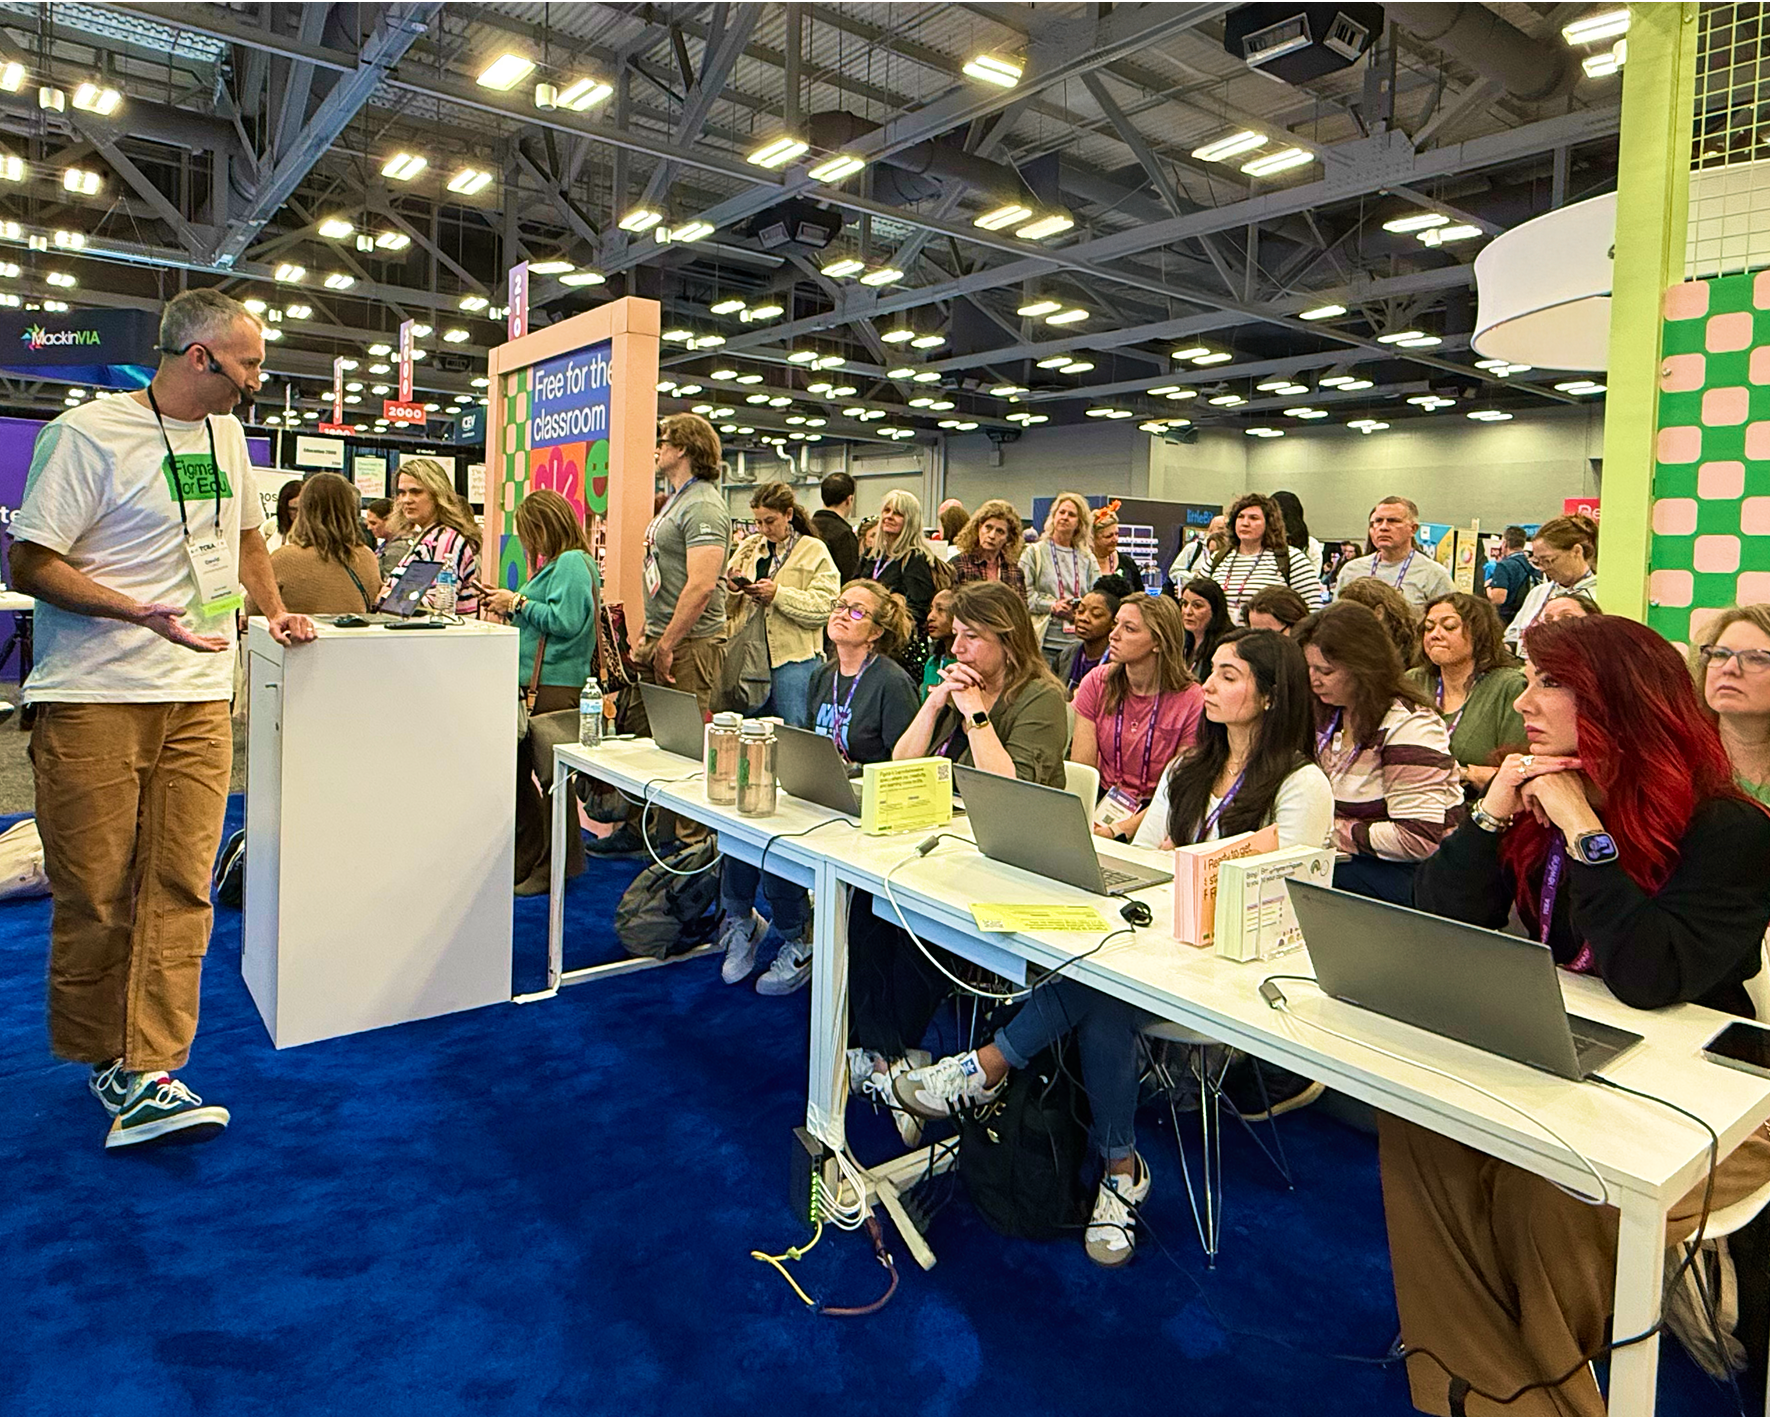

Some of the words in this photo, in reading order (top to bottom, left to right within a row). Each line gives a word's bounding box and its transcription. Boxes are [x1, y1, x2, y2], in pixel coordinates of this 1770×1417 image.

[31, 330, 101, 345] MackinVIA
[535, 369, 564, 403] Free
[566, 361, 588, 395] for
[388, 406, 422, 419] 2000
[533, 404, 606, 441] classroom
[174, 459, 215, 480] Figma
[180, 482, 195, 495] or
